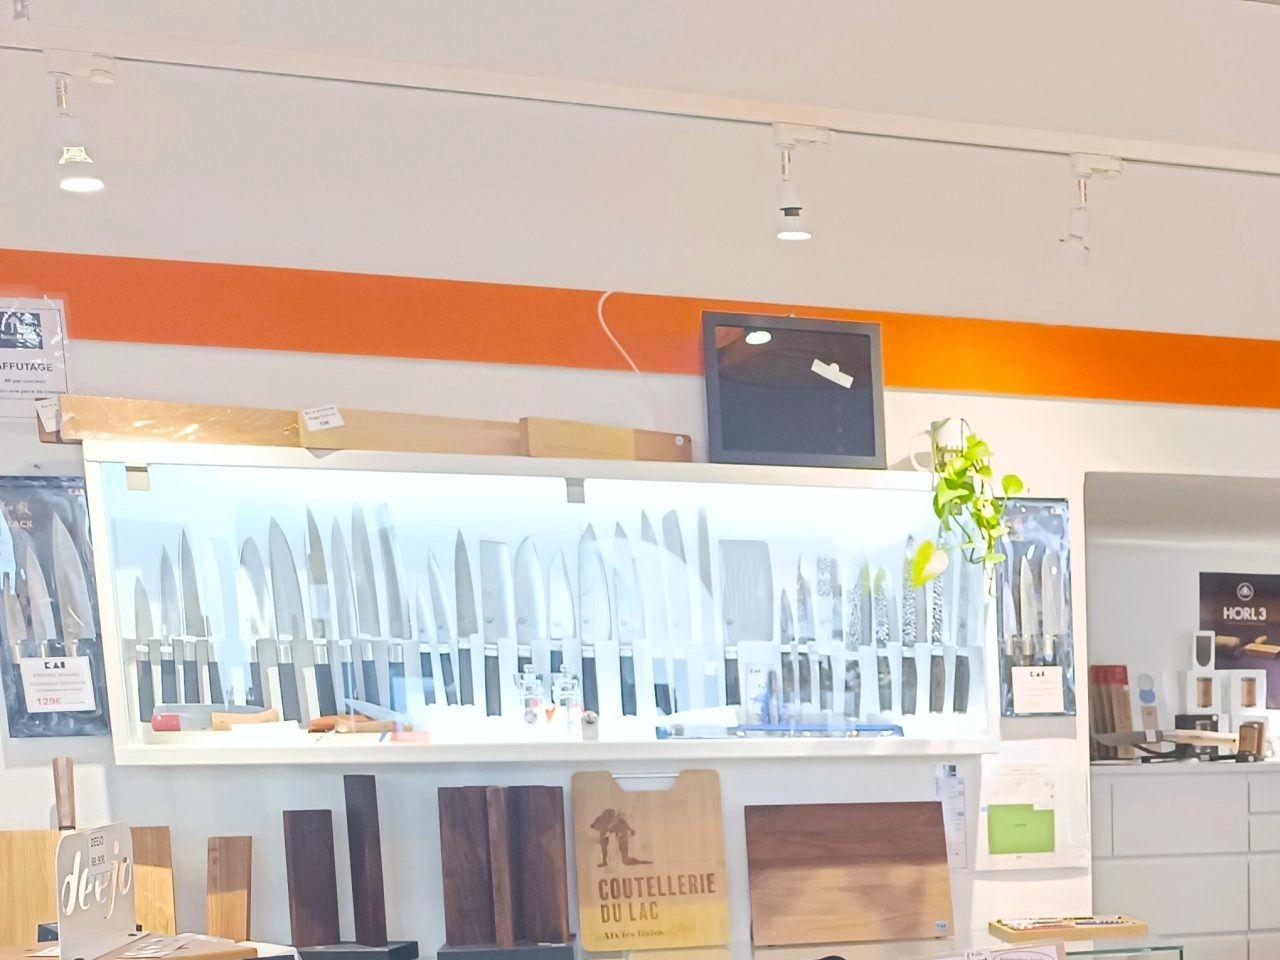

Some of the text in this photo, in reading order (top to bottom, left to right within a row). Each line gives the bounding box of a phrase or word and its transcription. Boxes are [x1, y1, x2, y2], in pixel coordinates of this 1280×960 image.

[1223, 606, 1267, 621] HORL 3
[62, 840, 132, 920] deejo
[598, 872, 717, 901] COUTELLERIE
[601, 901, 659, 923] DU LAC
